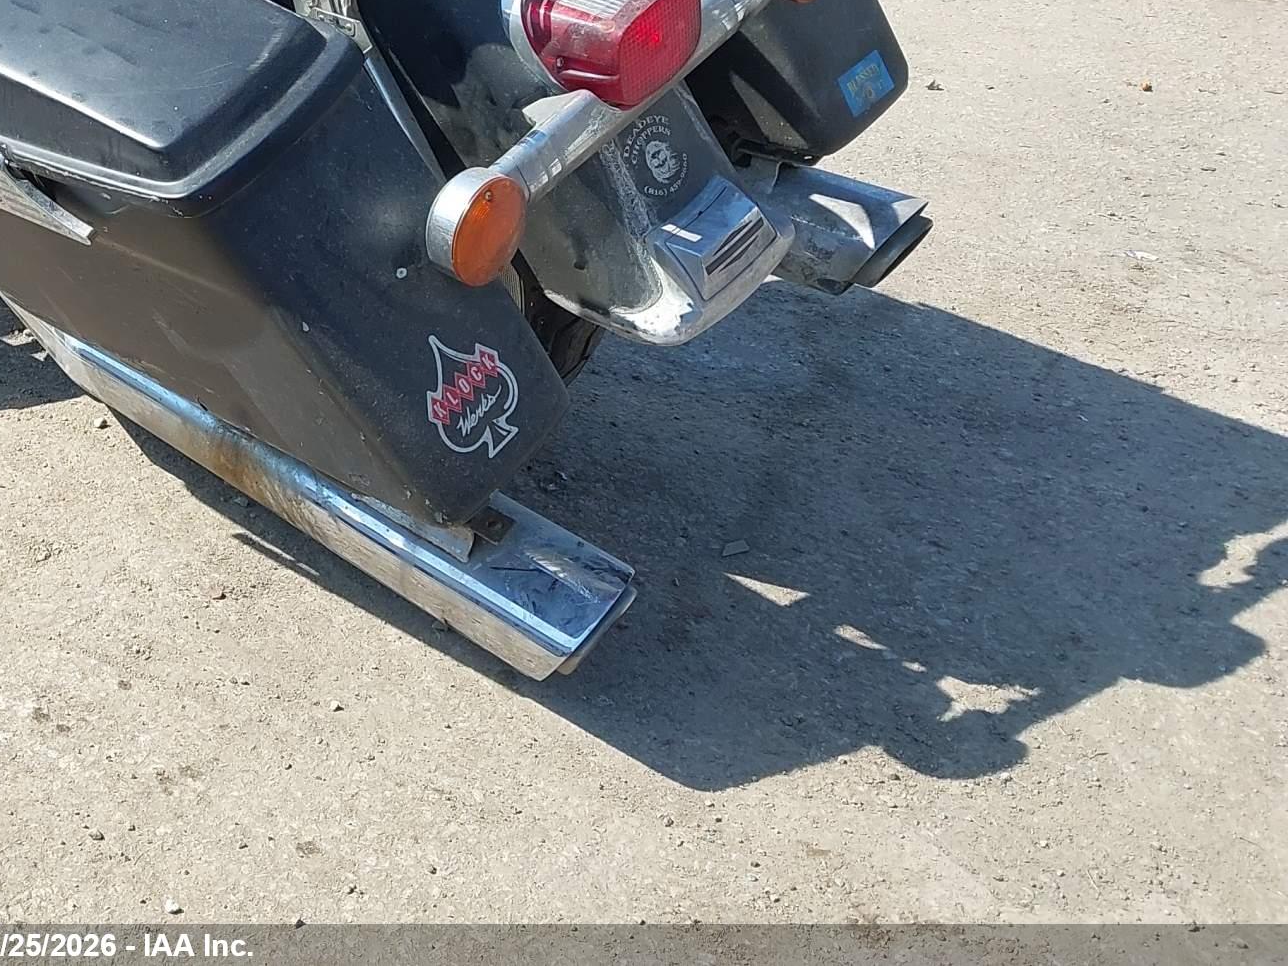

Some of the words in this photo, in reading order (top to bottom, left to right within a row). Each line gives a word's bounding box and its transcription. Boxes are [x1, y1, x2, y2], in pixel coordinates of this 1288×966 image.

[623, 115, 671, 158] DEADEYE
[631, 125, 672, 165] CHOPPERS
[432, 353, 495, 418] KLOCK
[456, 384, 502, 437] Werks
